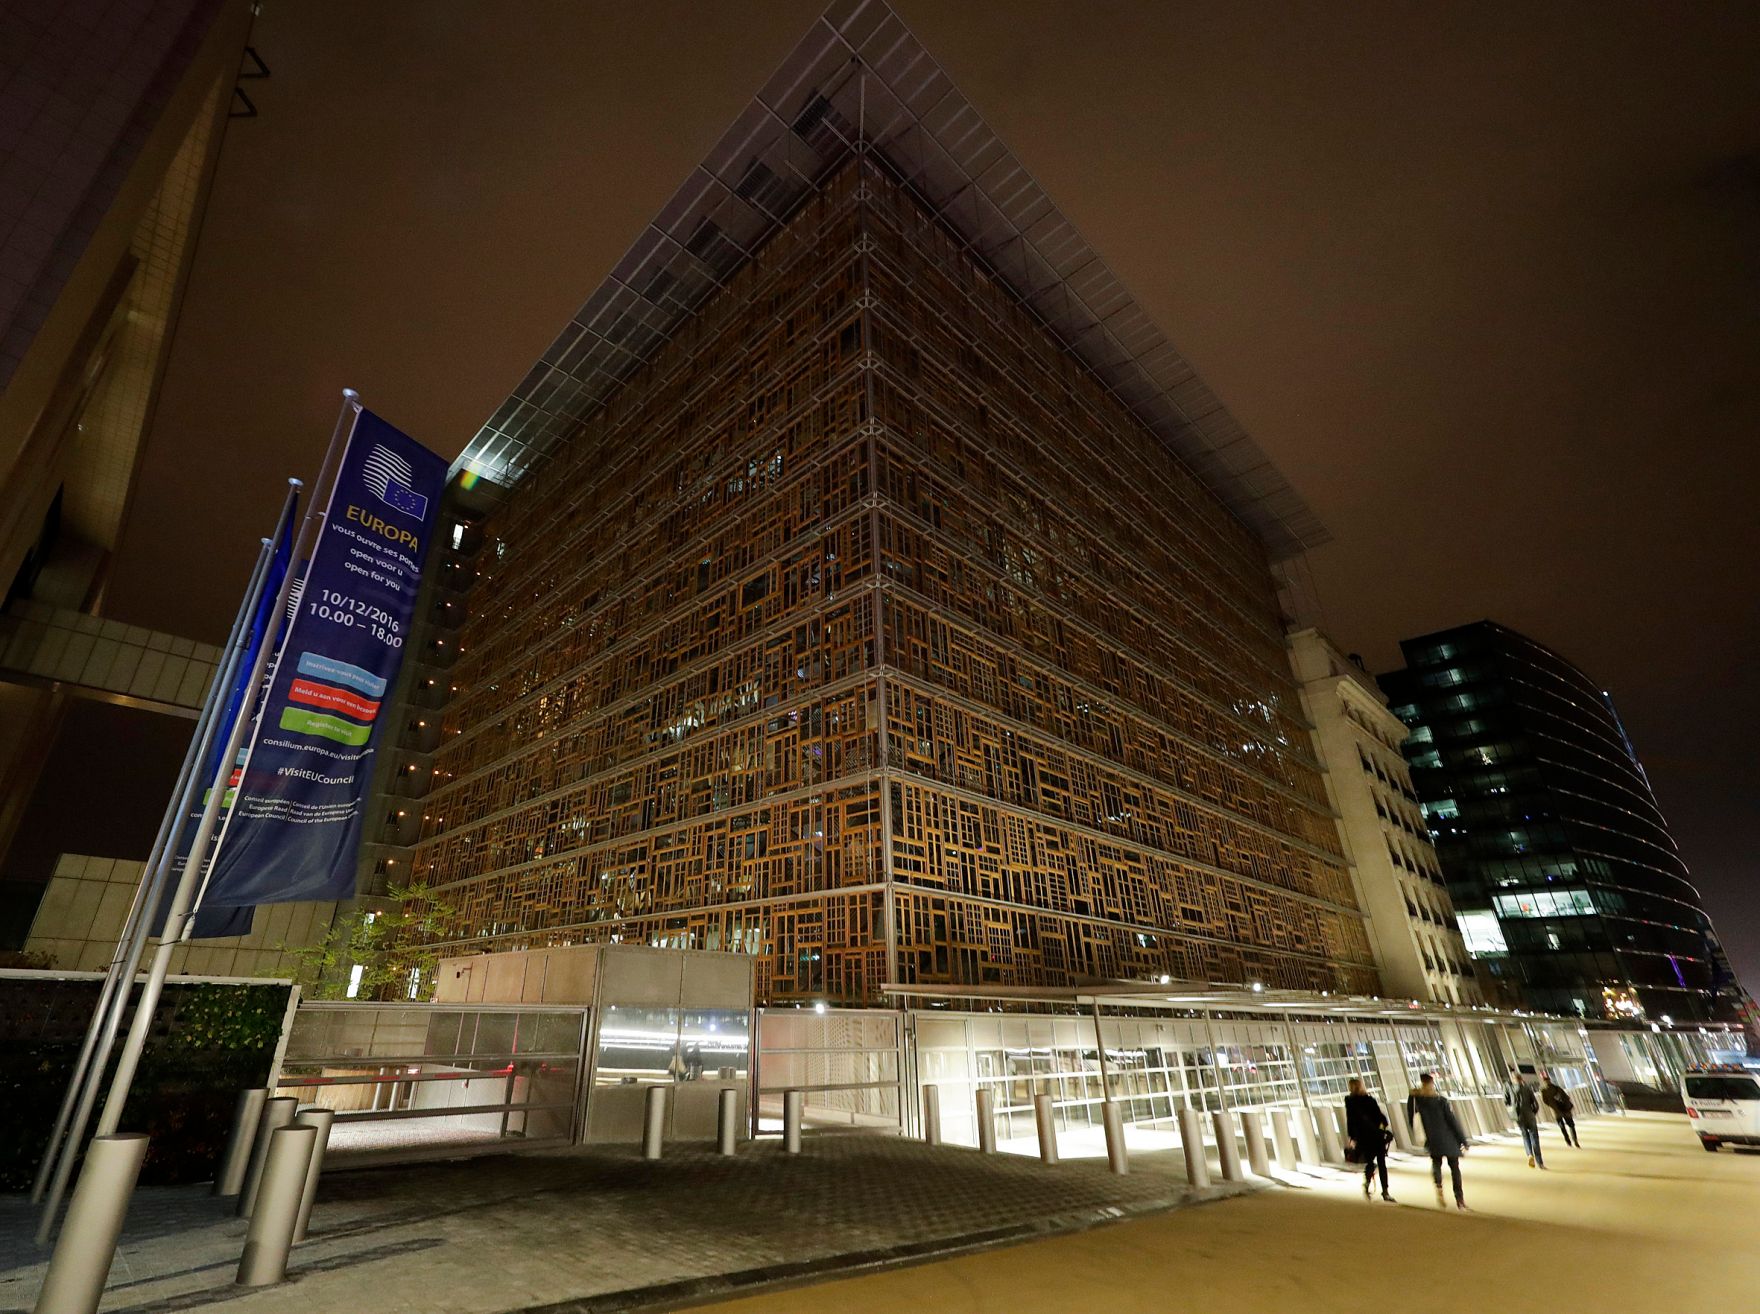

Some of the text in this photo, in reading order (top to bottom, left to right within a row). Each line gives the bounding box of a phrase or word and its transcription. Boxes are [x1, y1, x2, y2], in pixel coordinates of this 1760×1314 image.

[332, 523, 355, 538] vous
[356, 534, 382, 552] ouvre
[383, 547, 398, 558] ses
[346, 505, 418, 553] EUROPA
[350, 548, 374, 563] open
[376, 559, 397, 572] voor
[344, 562, 400, 591] open for you
[322, 589, 399, 632] 10/12/2016
[310, 603, 354, 626] 10.00
[371, 624, 403, 648] 18.00
[294, 687, 312, 696] Meld
[332, 697, 346, 705] voor
[306, 720, 334, 731] Register
[277, 767, 354, 785] #VisitEUCouncil
[265, 812, 286, 820] Council
[288, 816, 307, 824] Council
